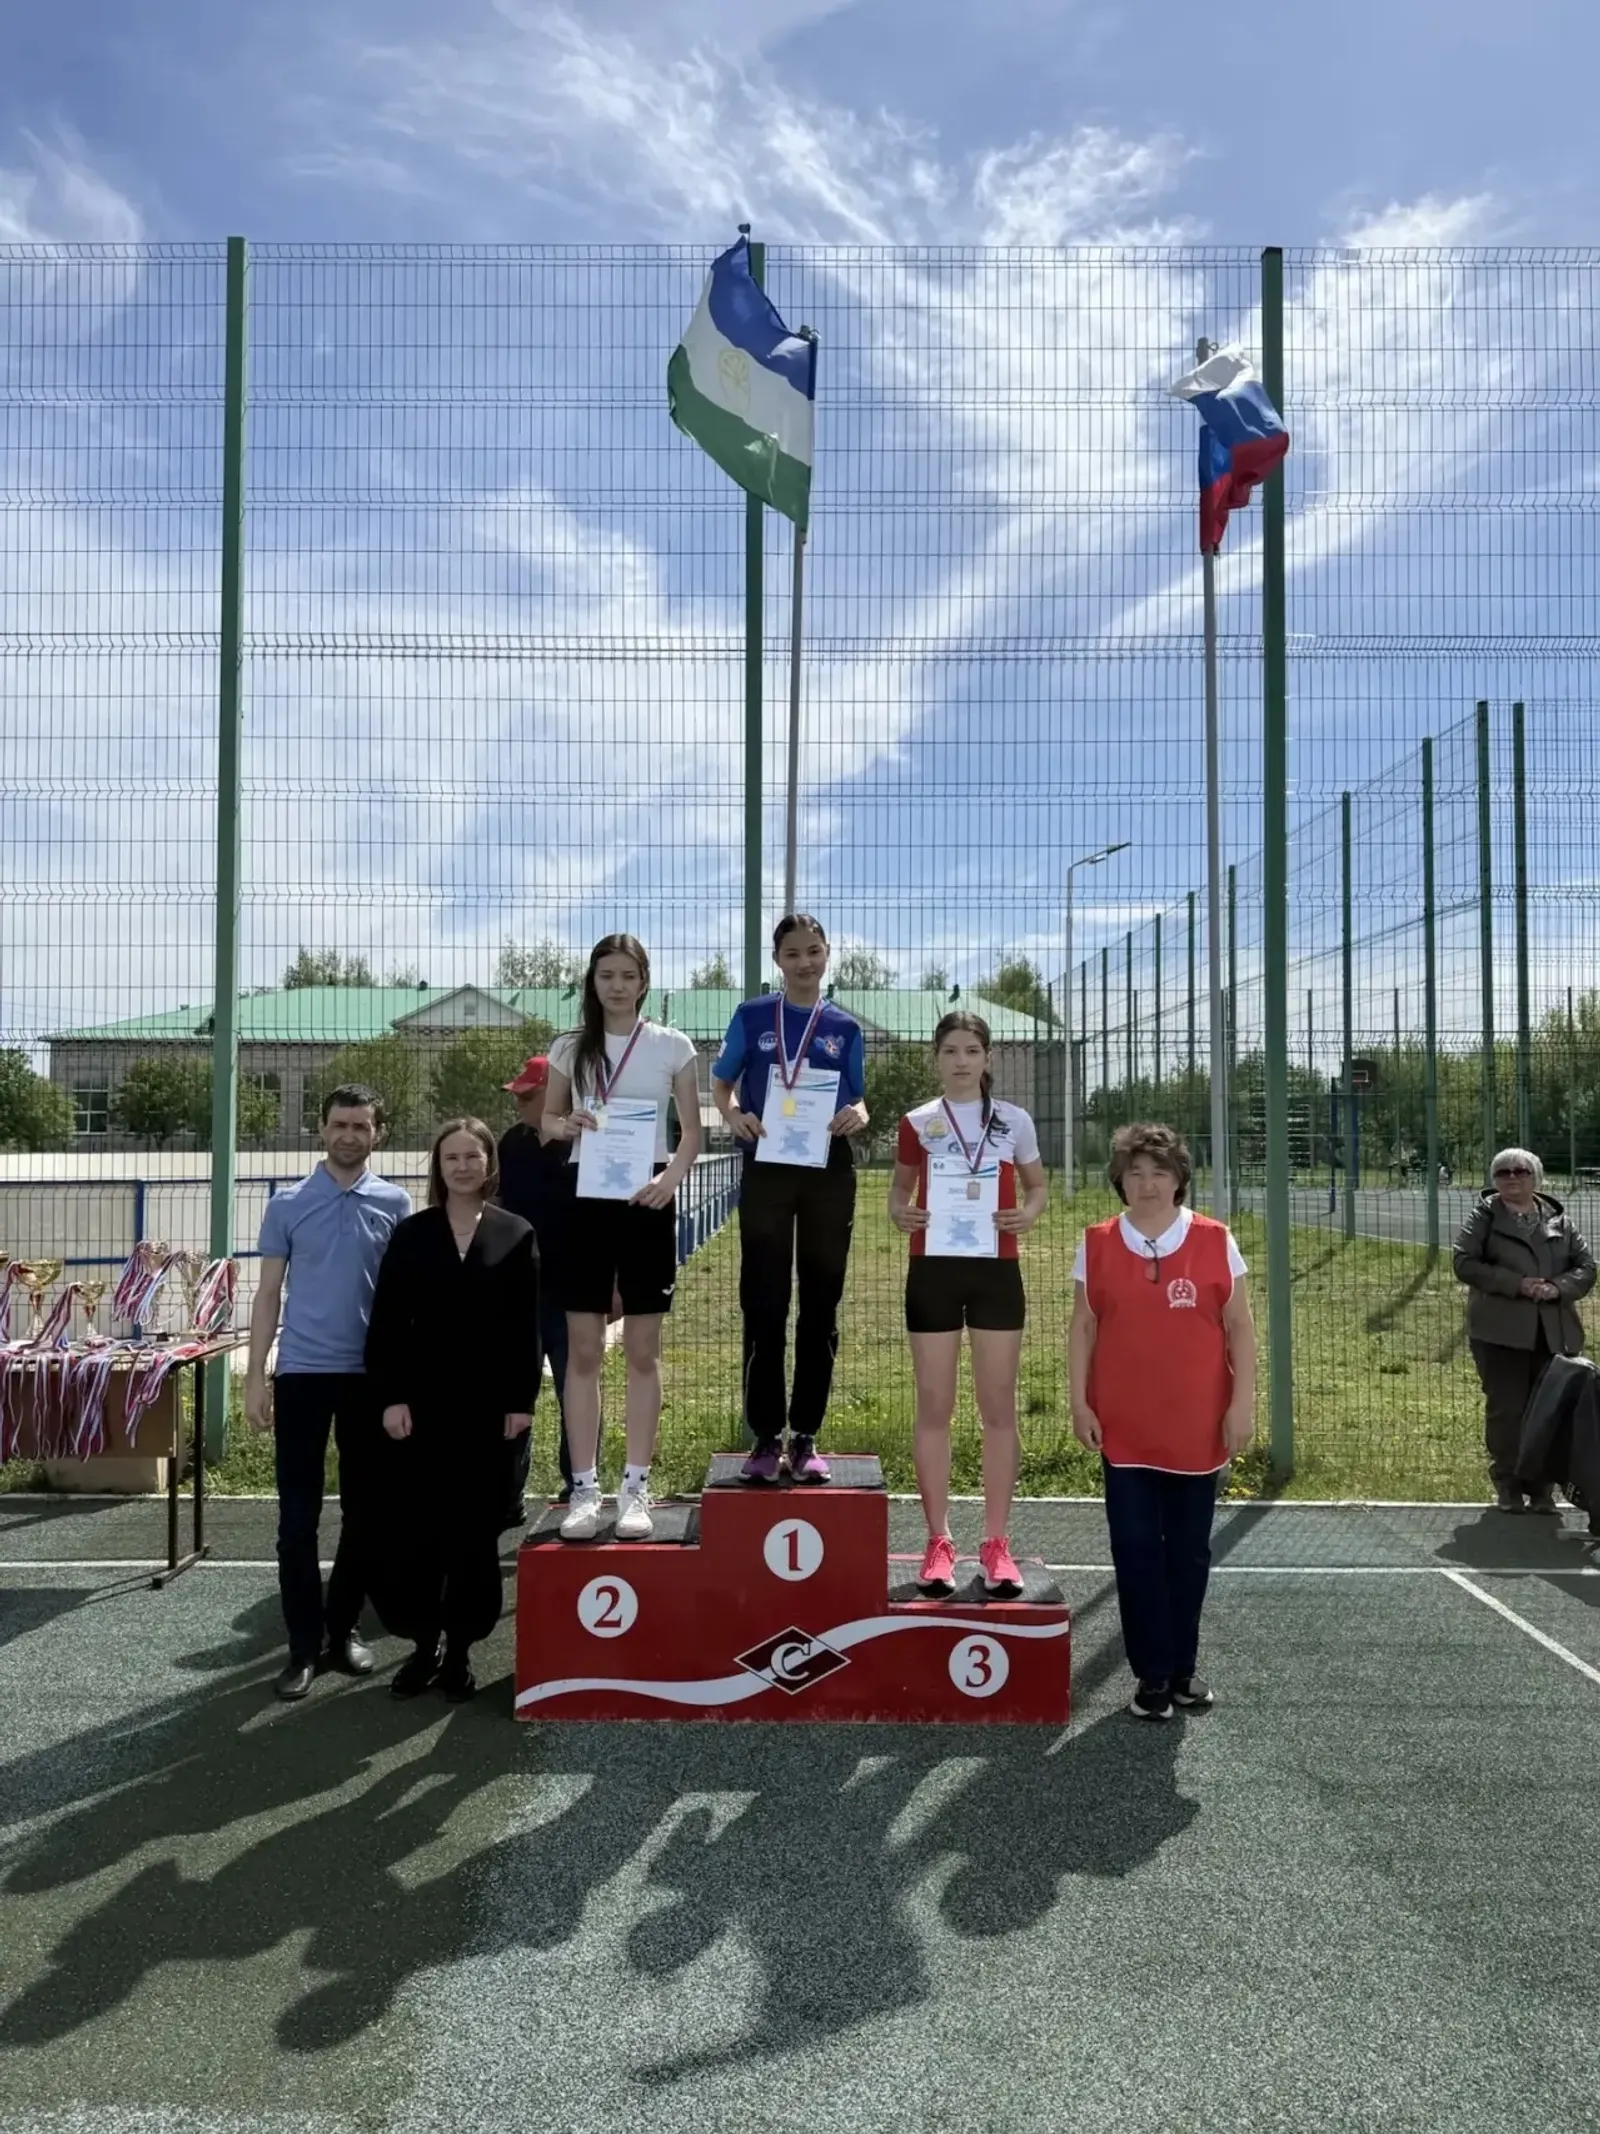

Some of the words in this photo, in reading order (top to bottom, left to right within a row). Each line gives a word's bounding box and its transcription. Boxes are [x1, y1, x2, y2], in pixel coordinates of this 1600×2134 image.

[781, 1529, 803, 1572] 1
[594, 1585, 624, 1628] 2
[965, 1644, 992, 1688] 3
